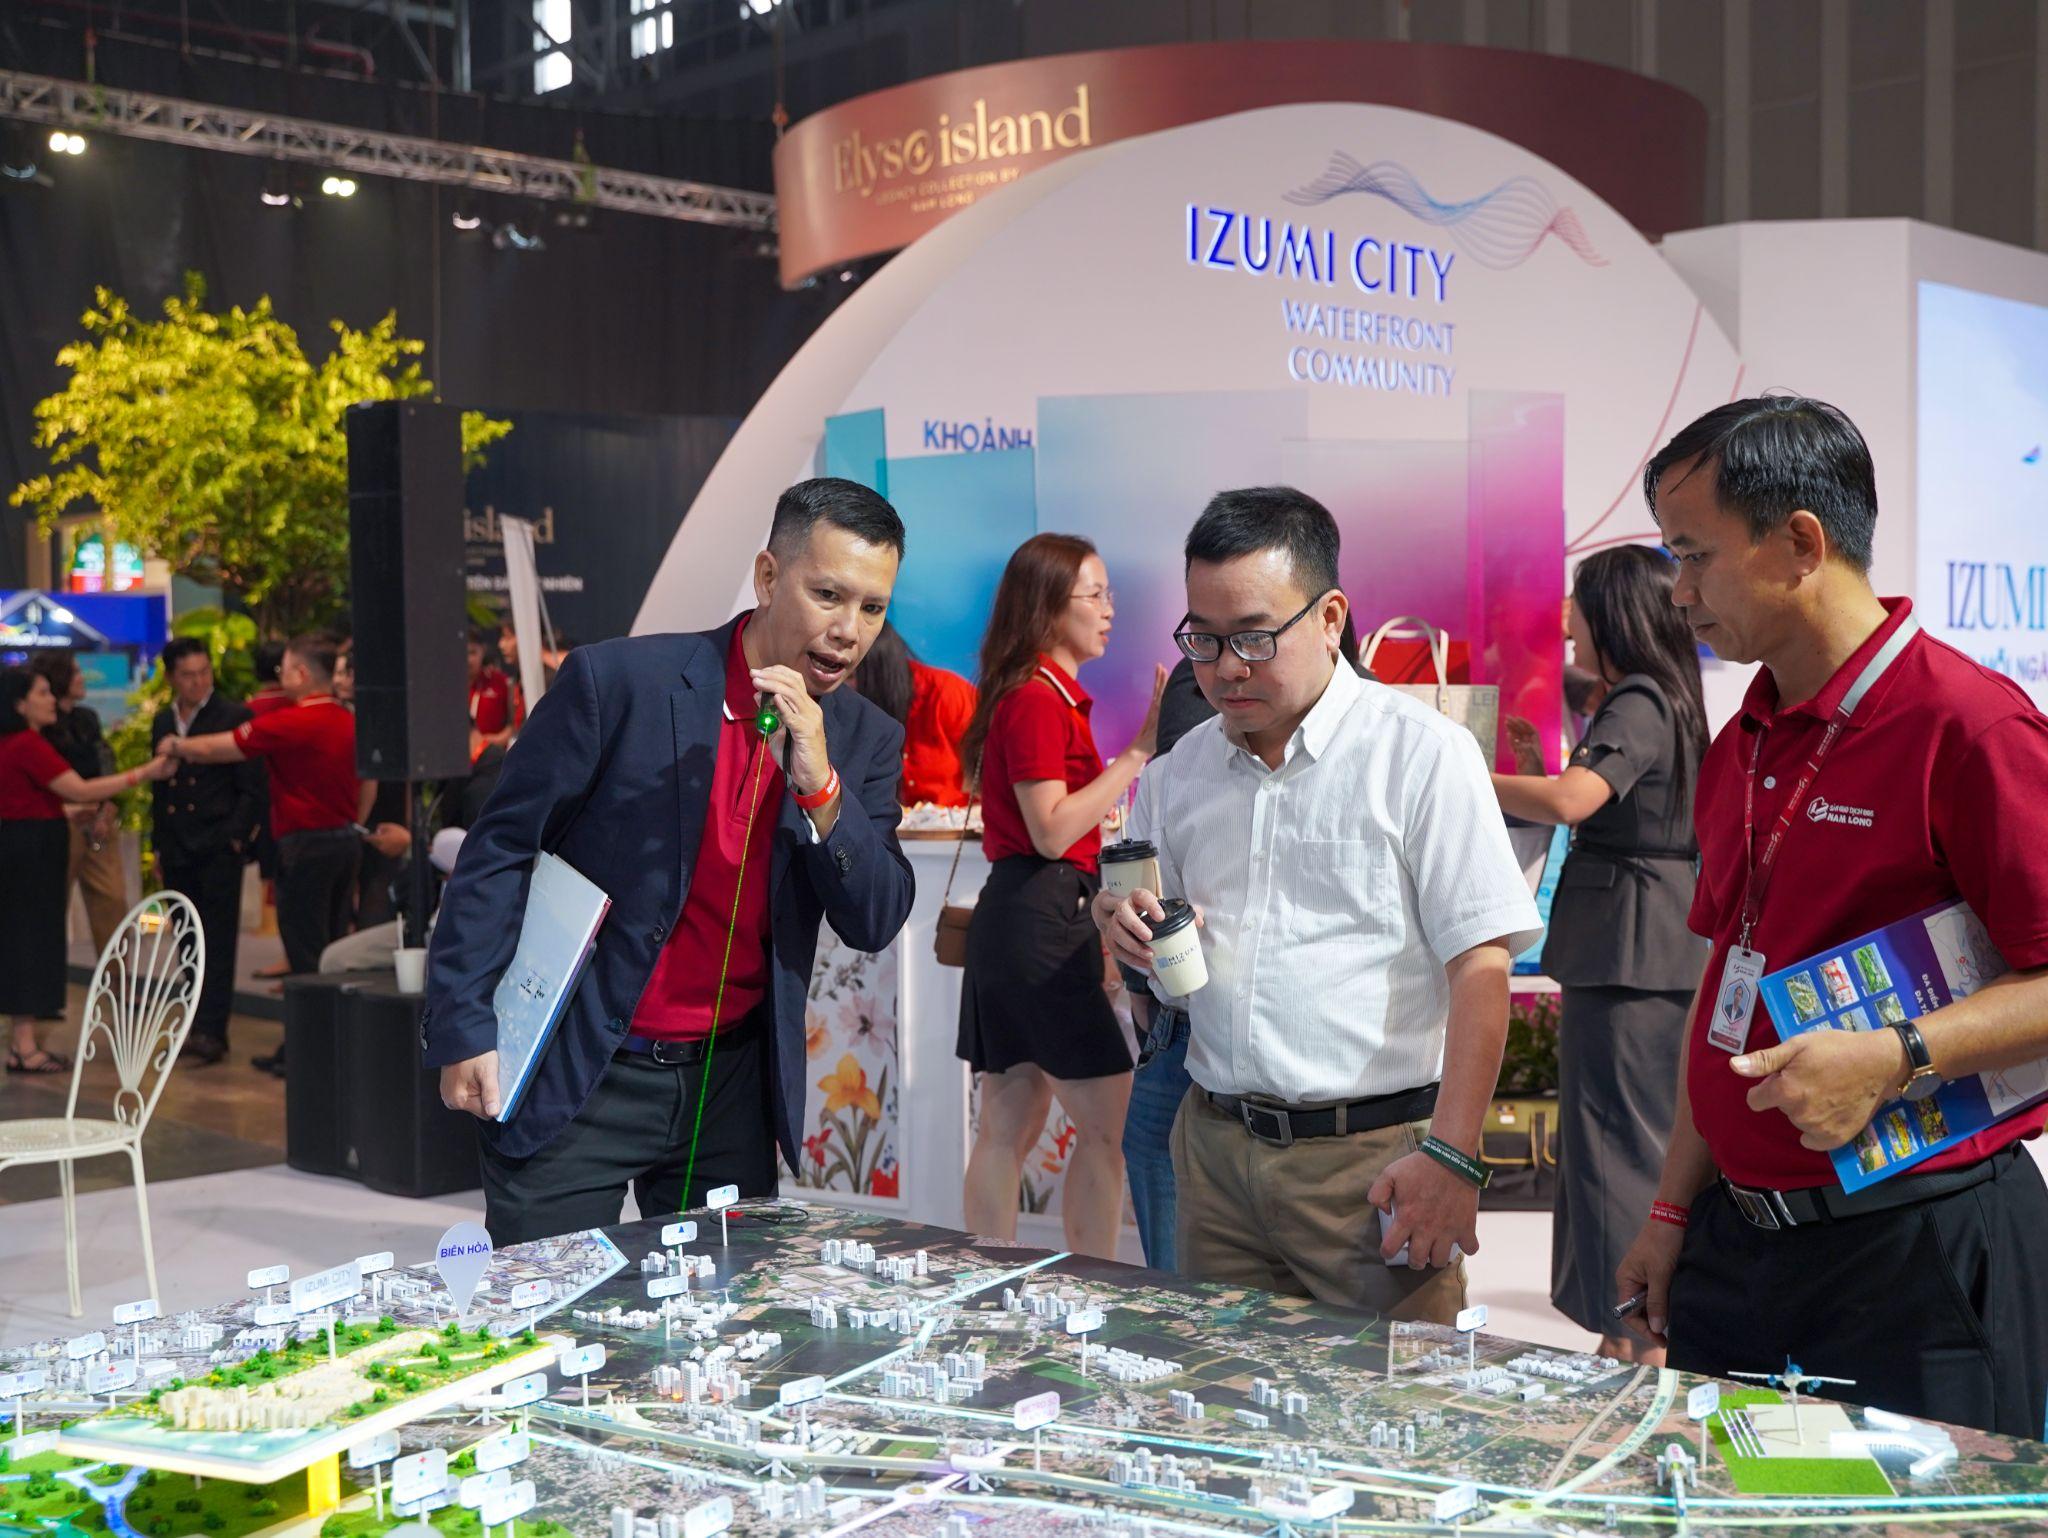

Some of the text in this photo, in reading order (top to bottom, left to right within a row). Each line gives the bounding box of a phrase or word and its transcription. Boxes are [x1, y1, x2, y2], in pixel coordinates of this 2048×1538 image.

[940, 83, 1092, 168] island
[1186, 202, 1456, 304] IZUMI CITY
[1281, 298, 1456, 355] WATERFRONT
[1287, 346, 1456, 397] COMMUNITY
[923, 417, 1032, 451] KHOẢNH
[1945, 560, 2048, 631] IZUMI
[1827, 813, 1873, 827] NAM LONG
[440, 1242, 489, 1258] BIÊN HÒA
